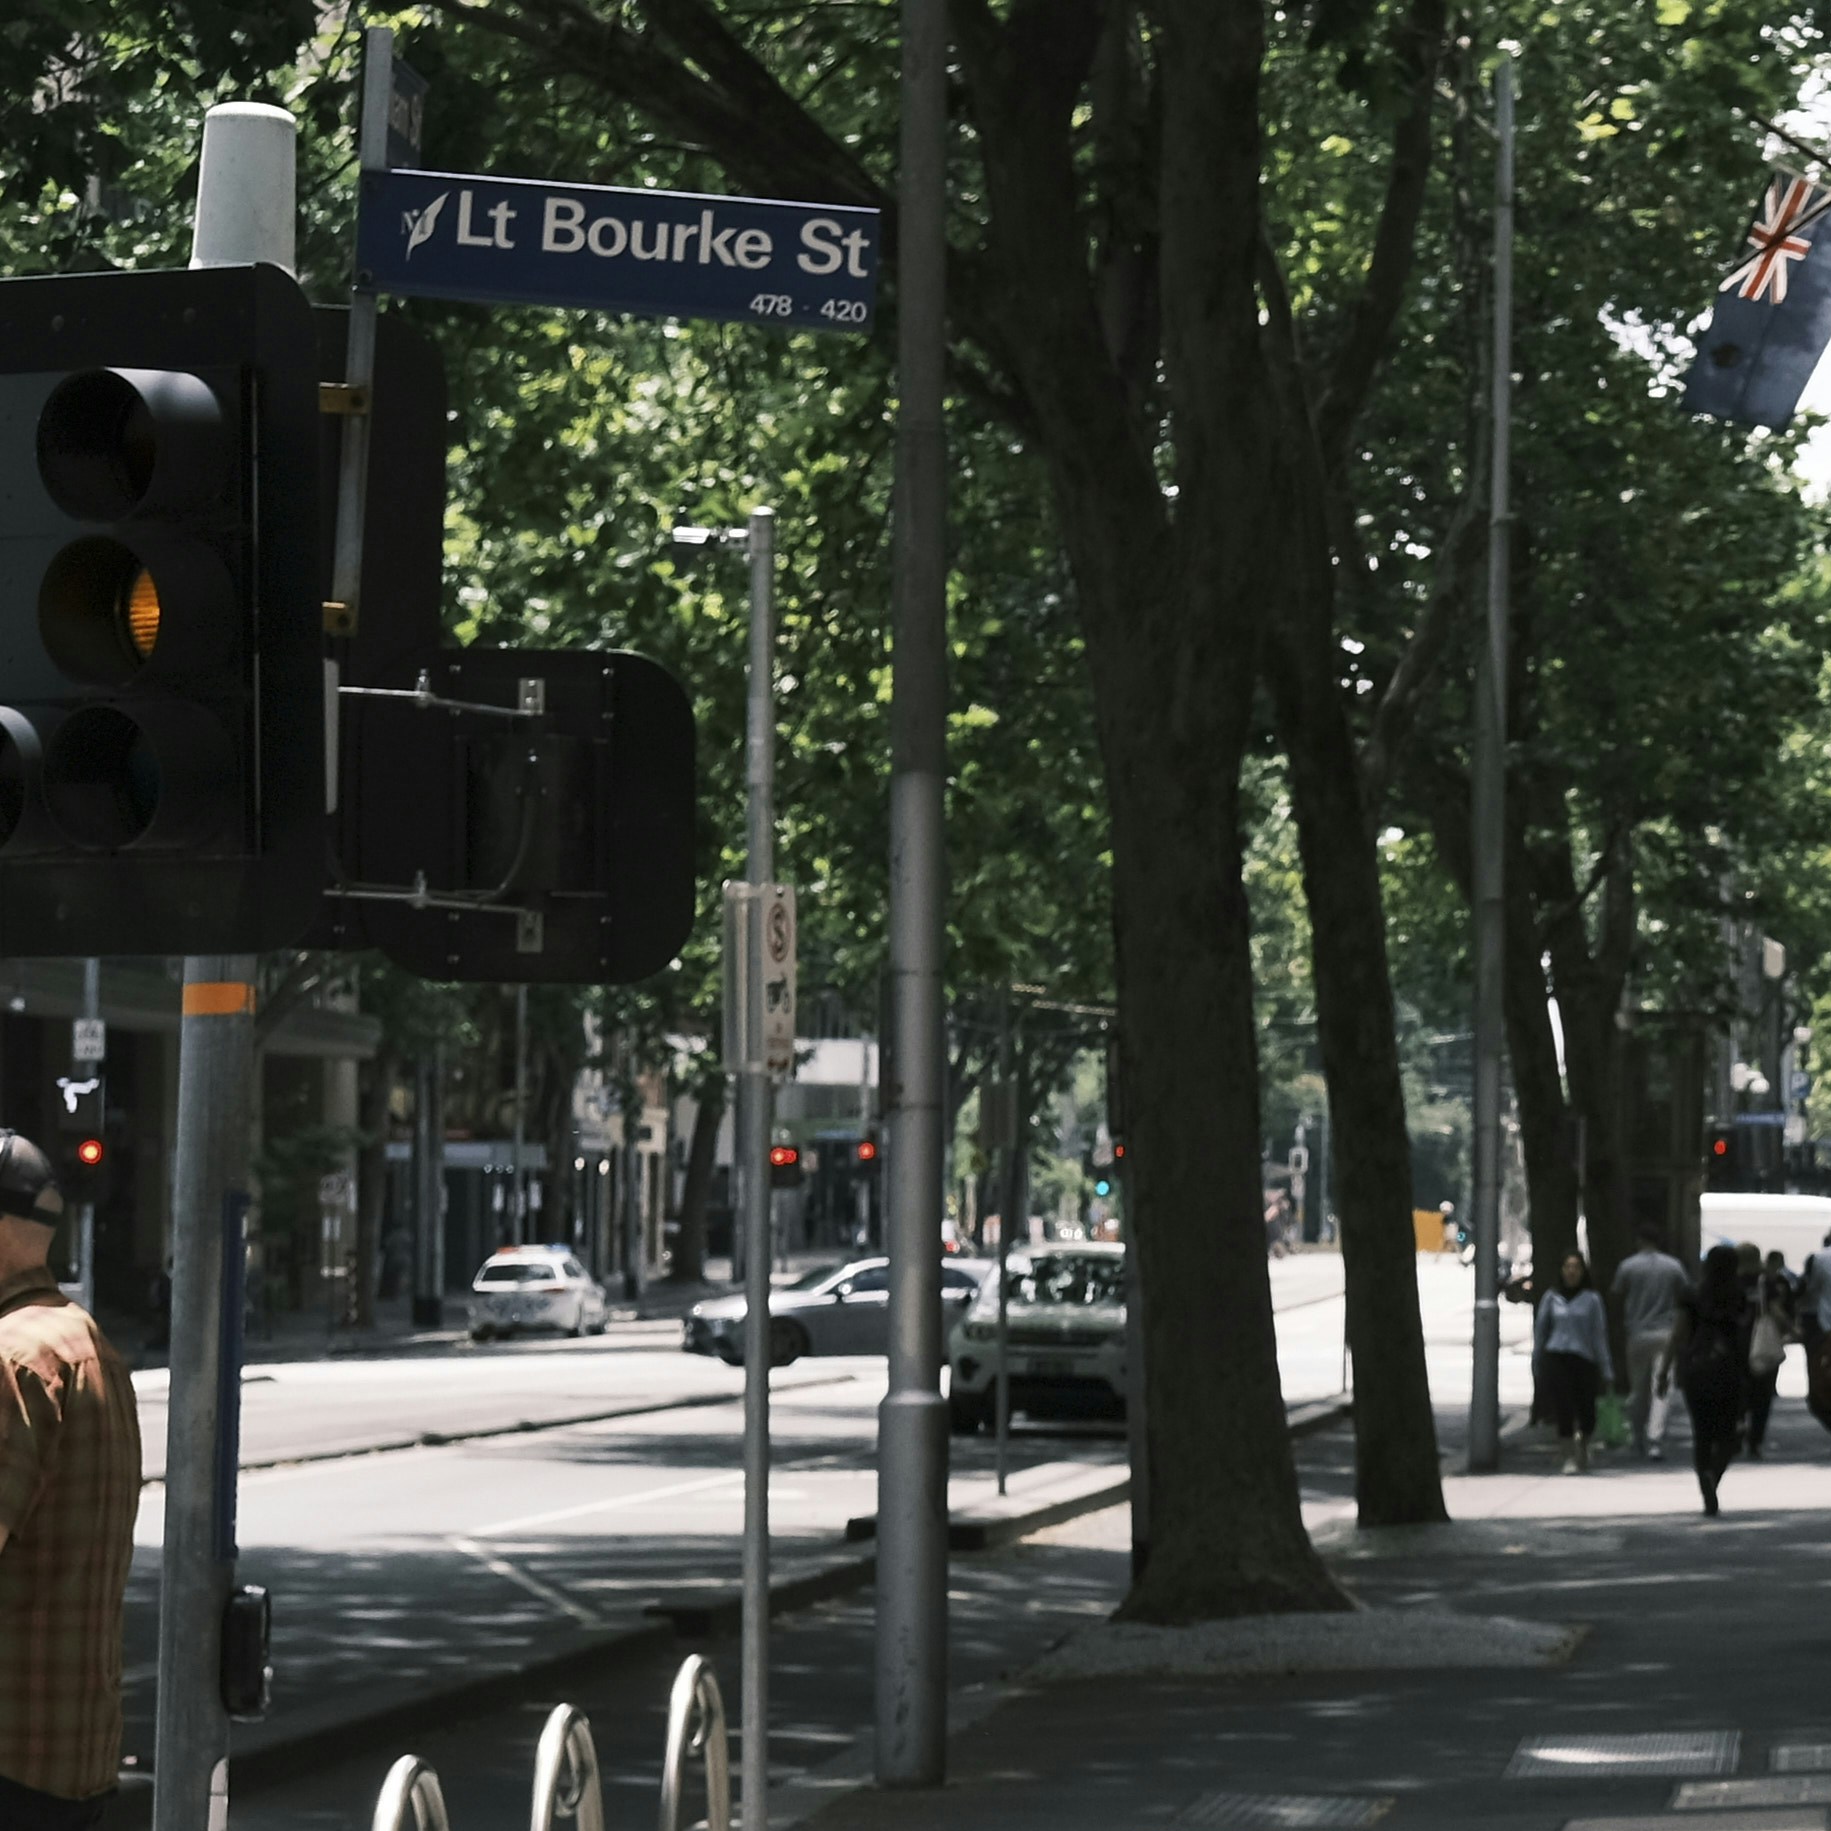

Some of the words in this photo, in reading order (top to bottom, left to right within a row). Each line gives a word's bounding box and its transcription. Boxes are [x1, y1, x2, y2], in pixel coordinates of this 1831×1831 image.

[457, 190, 517, 249] Lt
[541, 196, 774, 269] Bourke
[797, 219, 870, 277] St
[749, 294, 792, 317] 478
[820, 299, 867, 323] 420
